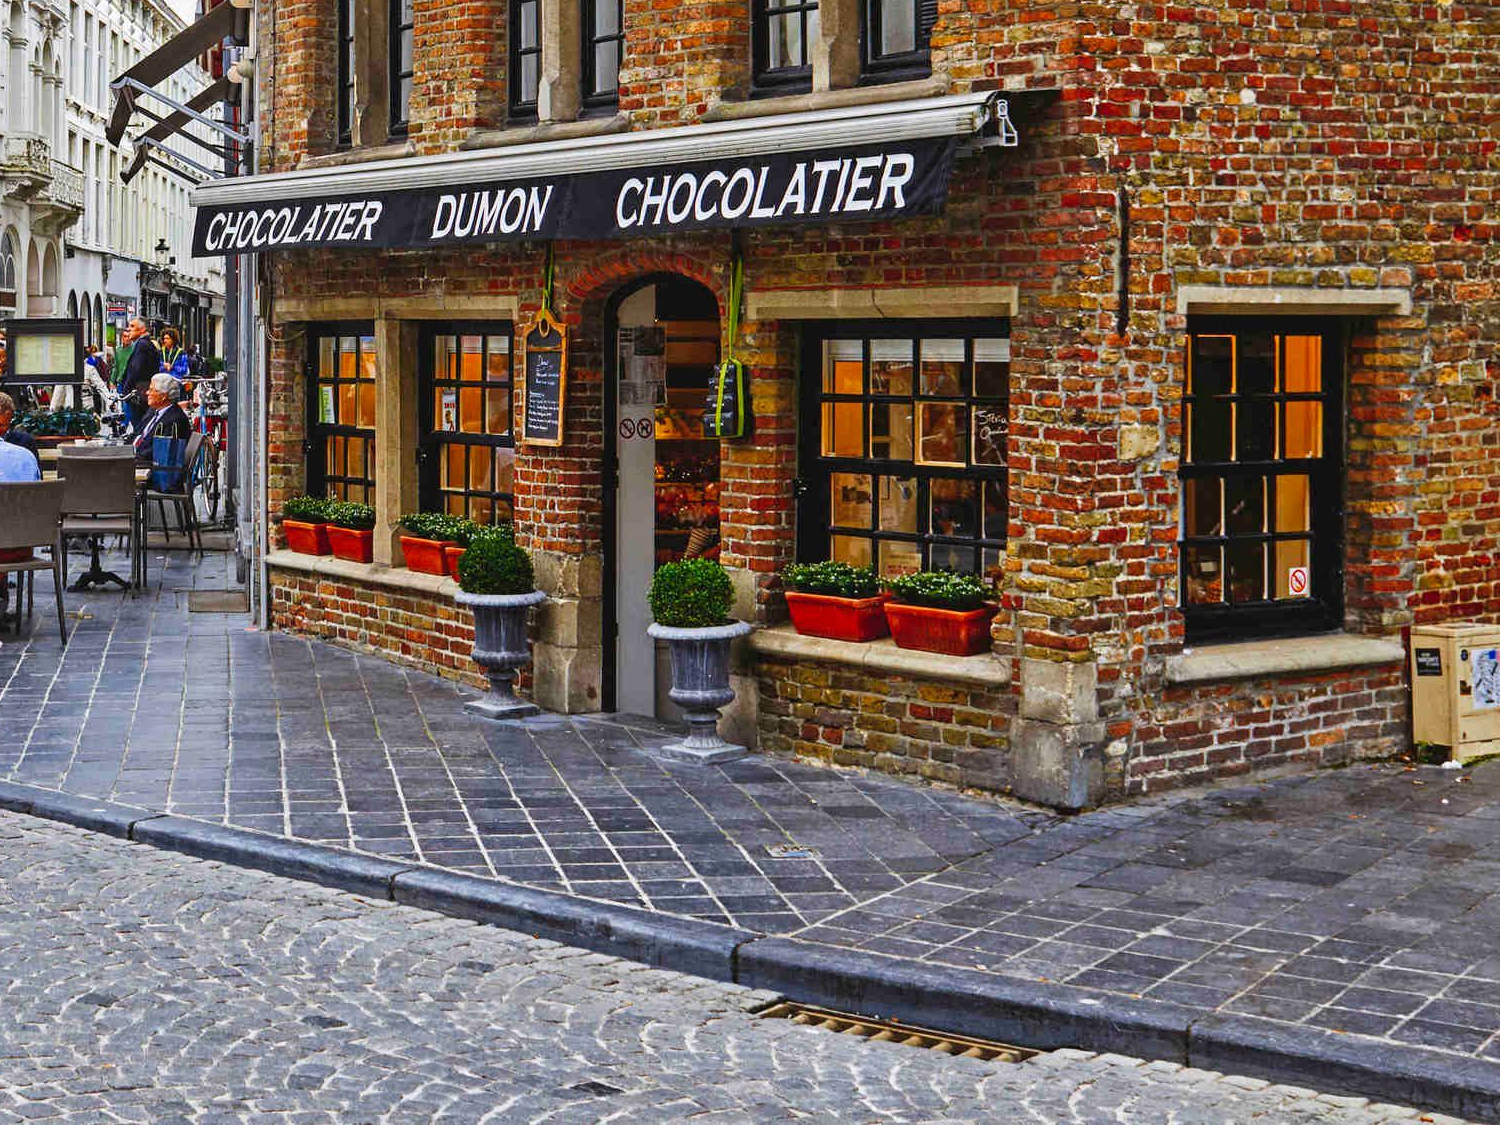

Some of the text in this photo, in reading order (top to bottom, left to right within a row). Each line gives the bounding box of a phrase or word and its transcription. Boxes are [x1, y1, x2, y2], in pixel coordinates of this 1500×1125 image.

[205, 153, 915, 251] CHOCOLATIER DUMON CHOCOLATIER
